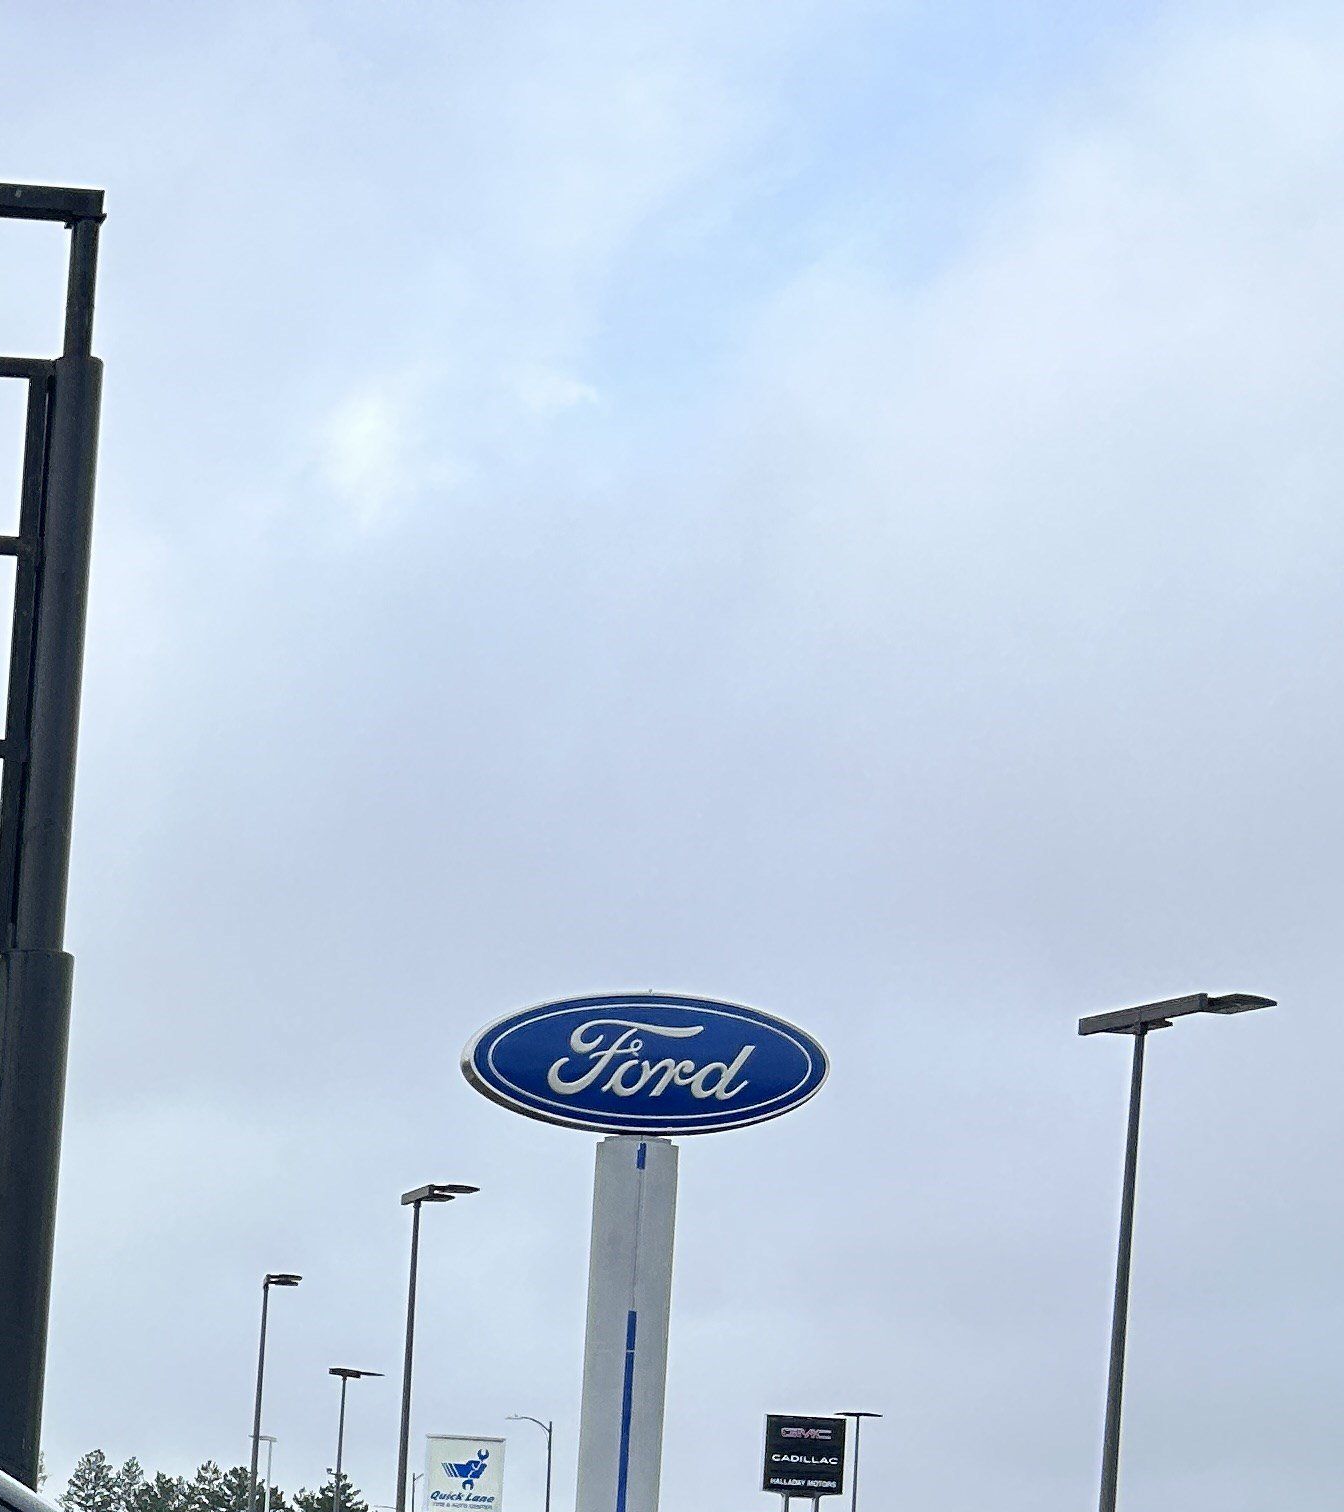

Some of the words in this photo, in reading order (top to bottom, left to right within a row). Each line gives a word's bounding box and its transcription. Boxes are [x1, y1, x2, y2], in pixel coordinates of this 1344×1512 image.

[547, 1019, 756, 1101] Ford
[781, 1427, 832, 1440] GMC
[771, 1454, 839, 1465] CADILLAC
[806, 1480, 837, 1488] MOTORS
[430, 1490, 462, 1502] Quick
[464, 1492, 495, 1503] Lane
